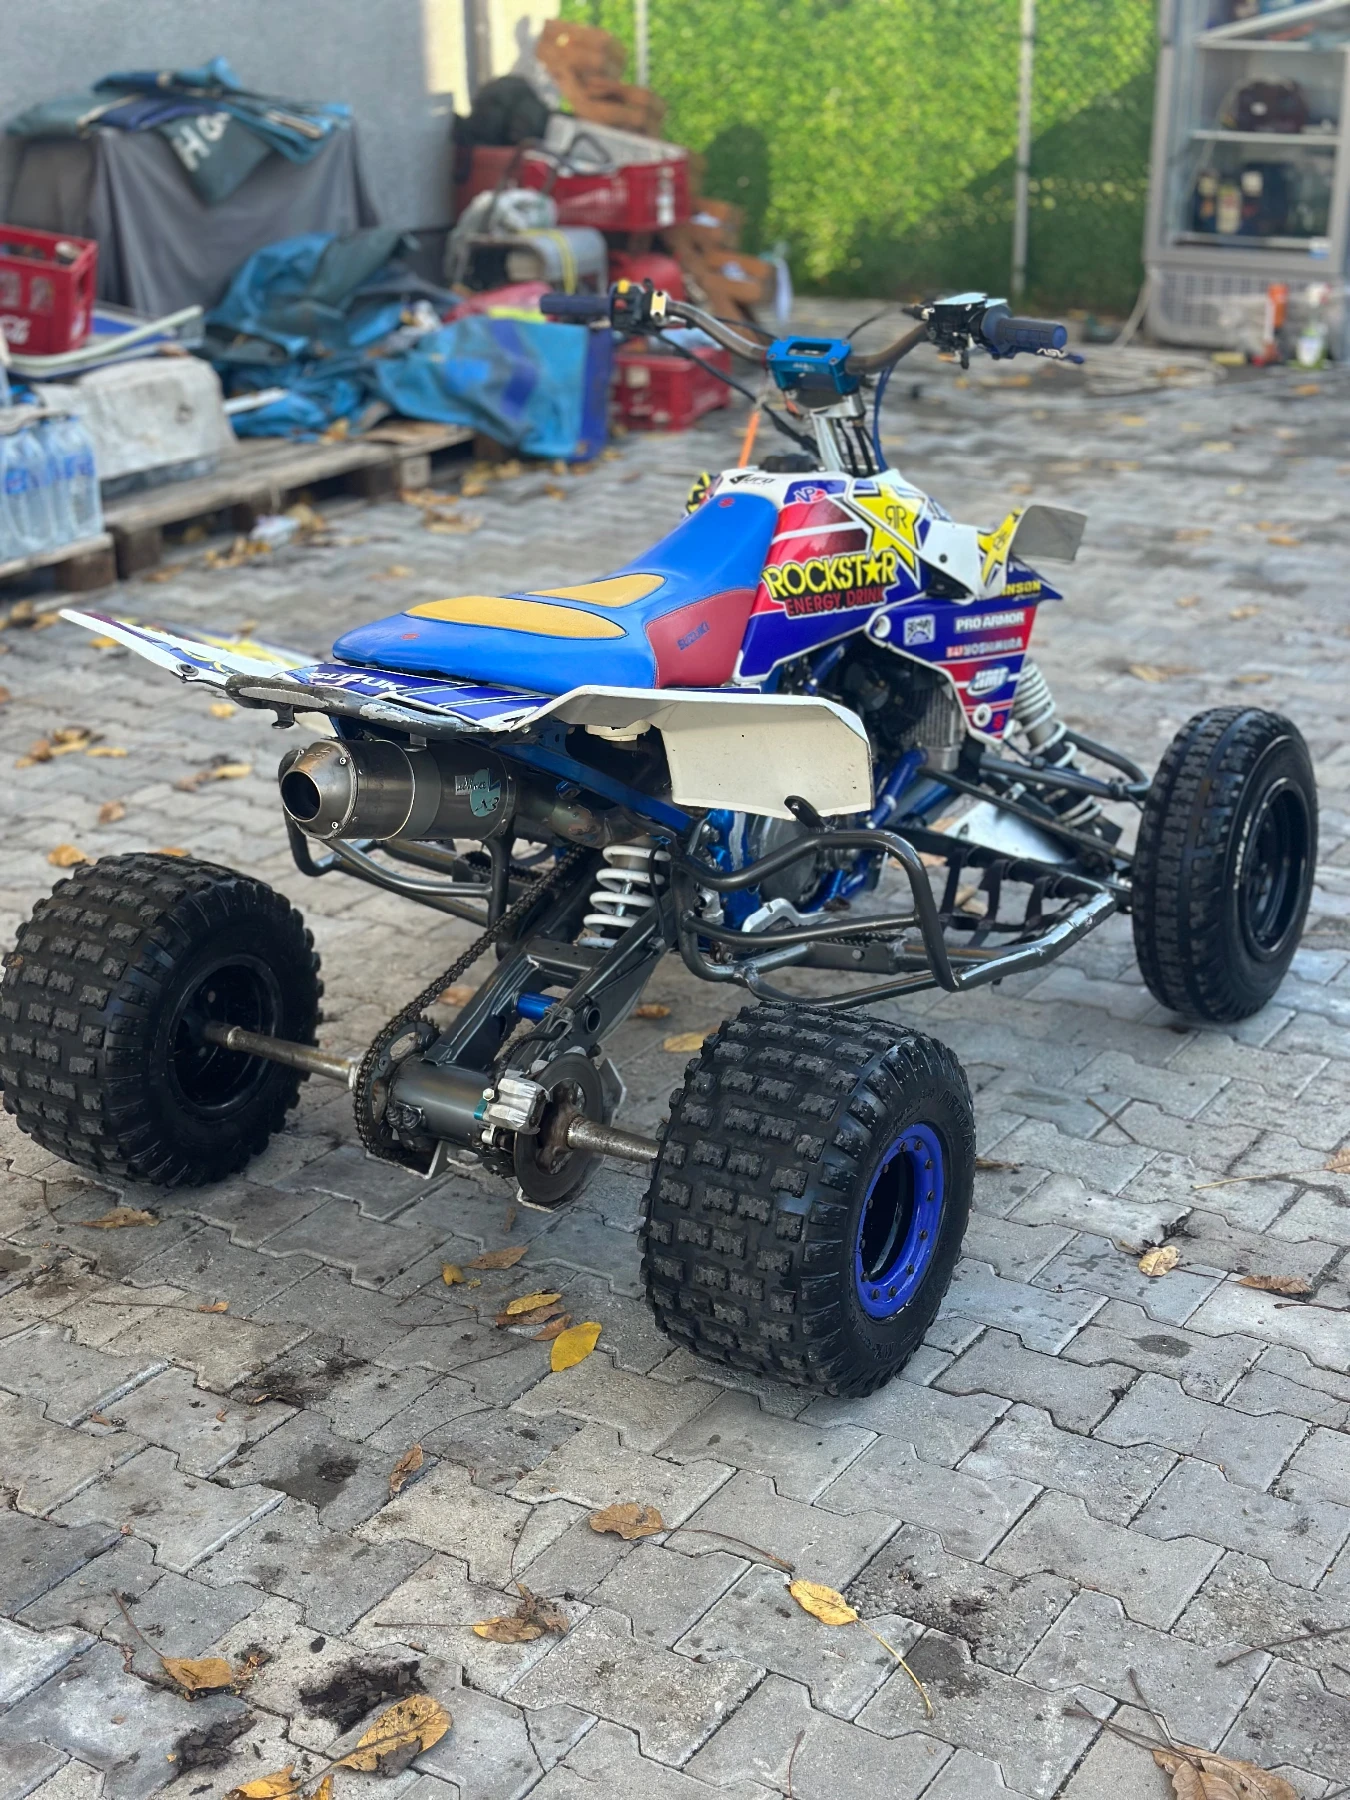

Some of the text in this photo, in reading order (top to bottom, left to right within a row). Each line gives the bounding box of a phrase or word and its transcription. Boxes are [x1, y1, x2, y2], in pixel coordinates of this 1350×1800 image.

[785, 586, 886, 615] ENERGY DRINK
[956, 611, 1025, 631] PRO ARMOR
[677, 621, 710, 651] SUZUKI
[306, 673, 409, 691] SUZUK
